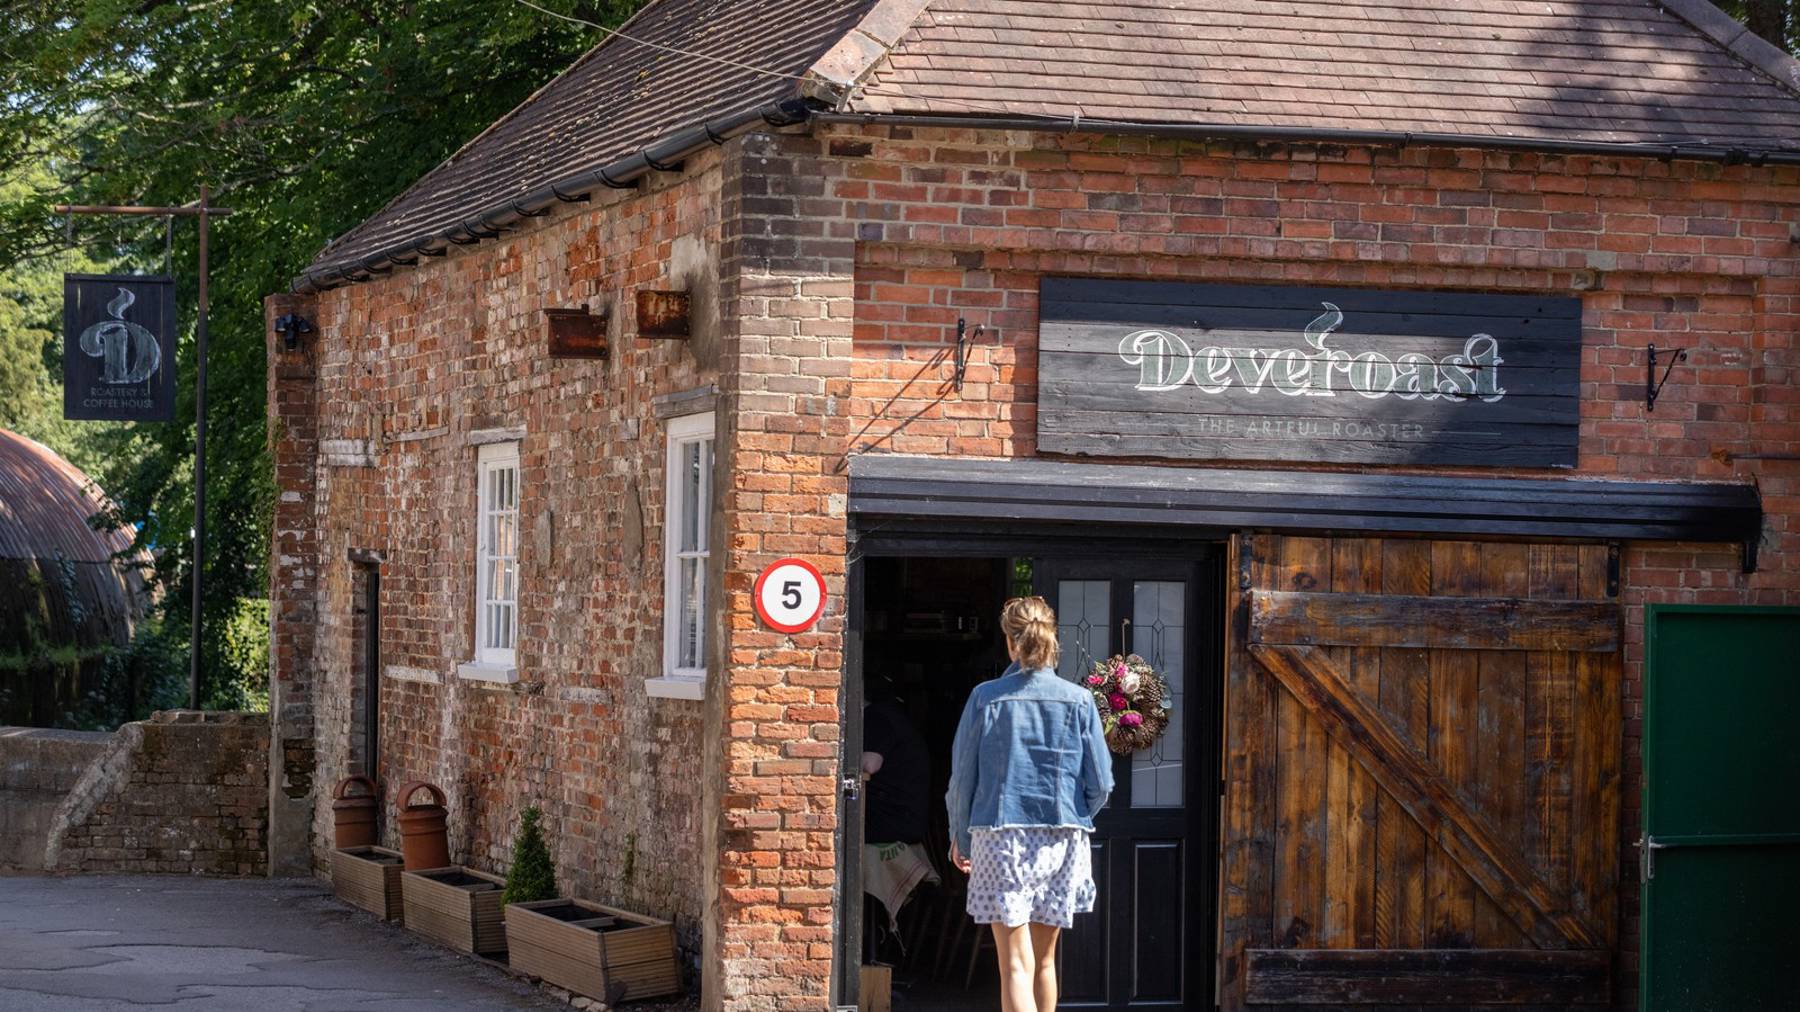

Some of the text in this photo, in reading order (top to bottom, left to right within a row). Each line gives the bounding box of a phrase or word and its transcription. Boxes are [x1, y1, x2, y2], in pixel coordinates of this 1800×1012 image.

[1118, 328, 1507, 403] Deveroast
[83, 399, 153, 409] COFFEE HOUSE
[1199, 418, 1425, 439] THE ARTFUL ROASTER
[782, 581, 802, 610] 5
